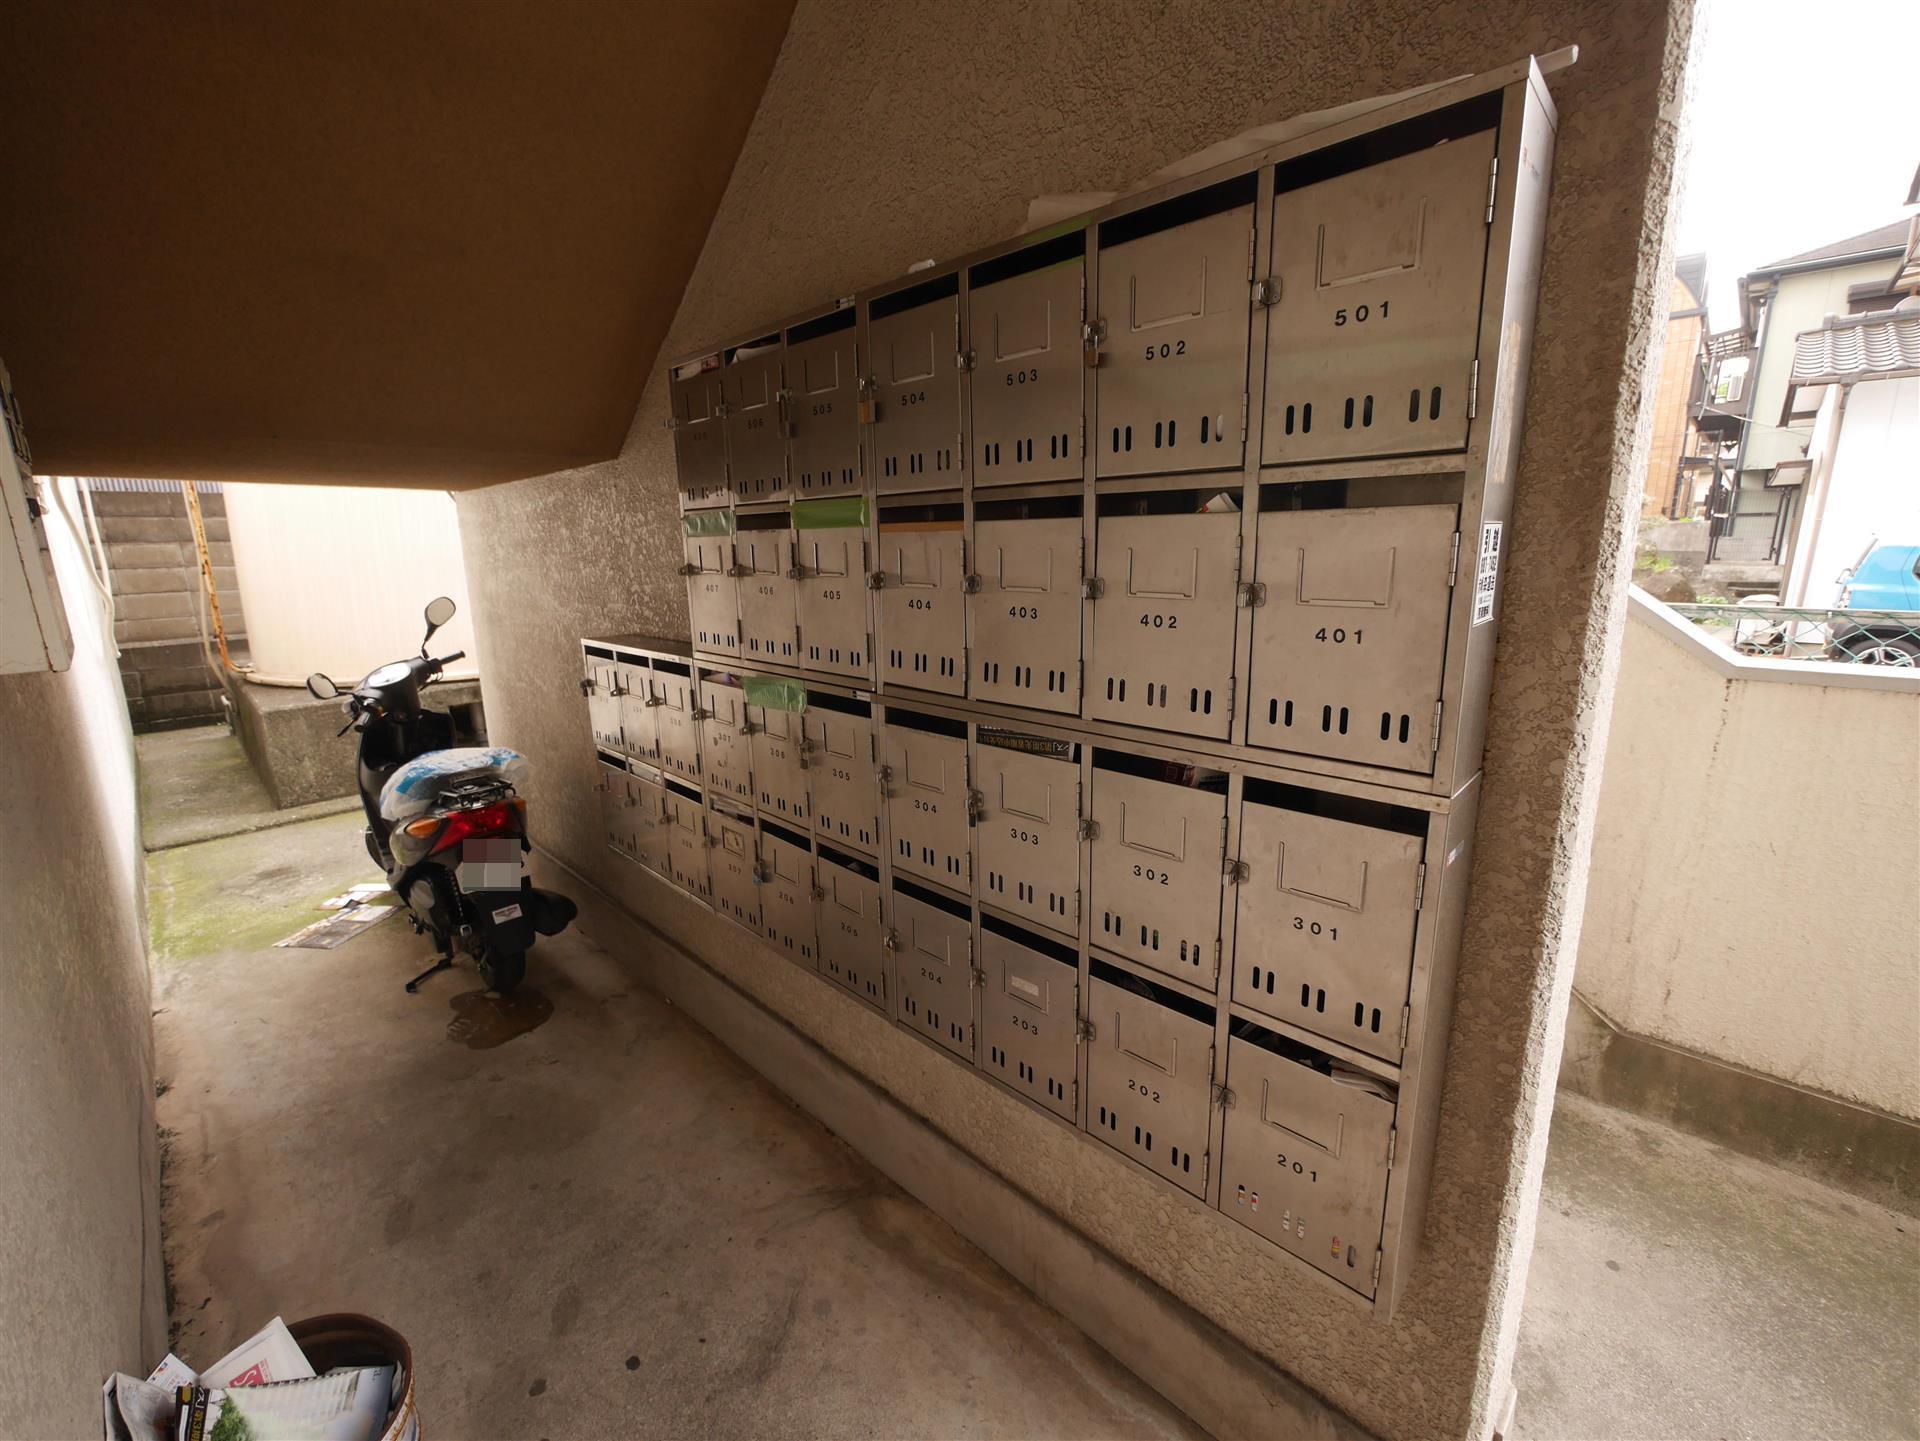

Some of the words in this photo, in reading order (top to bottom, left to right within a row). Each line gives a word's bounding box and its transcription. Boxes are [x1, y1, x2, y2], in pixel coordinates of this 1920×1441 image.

[1334, 301, 1389, 327] 501
[1145, 340, 1186, 361] 502
[1006, 368, 1038, 386] 503
[901, 391, 925, 406] 504
[812, 403, 832, 416] 505
[706, 584, 718, 593] 407
[759, 586, 774, 595] 406
[823, 590, 841, 600] 405
[908, 599, 931, 610] 404
[1009, 606, 1038, 619] 403
[1140, 614, 1177, 629] 402
[1315, 628, 1363, 645] 401
[718, 732, 731, 742] 307
[770, 747, 785, 759] 306
[832, 768, 850, 781] 305
[915, 799, 937, 813] 304
[1010, 828, 1039, 846] 303
[1133, 865, 1169, 885] 302
[779, 891, 794, 905] 206
[841, 921, 858, 937] 205
[1293, 916, 1338, 941] 301
[921, 967, 942, 984] 204
[1012, 1015, 1039, 1036] 203
[1128, 1079, 1161, 1104] 202
[1277, 1154, 1317, 1183] 201
